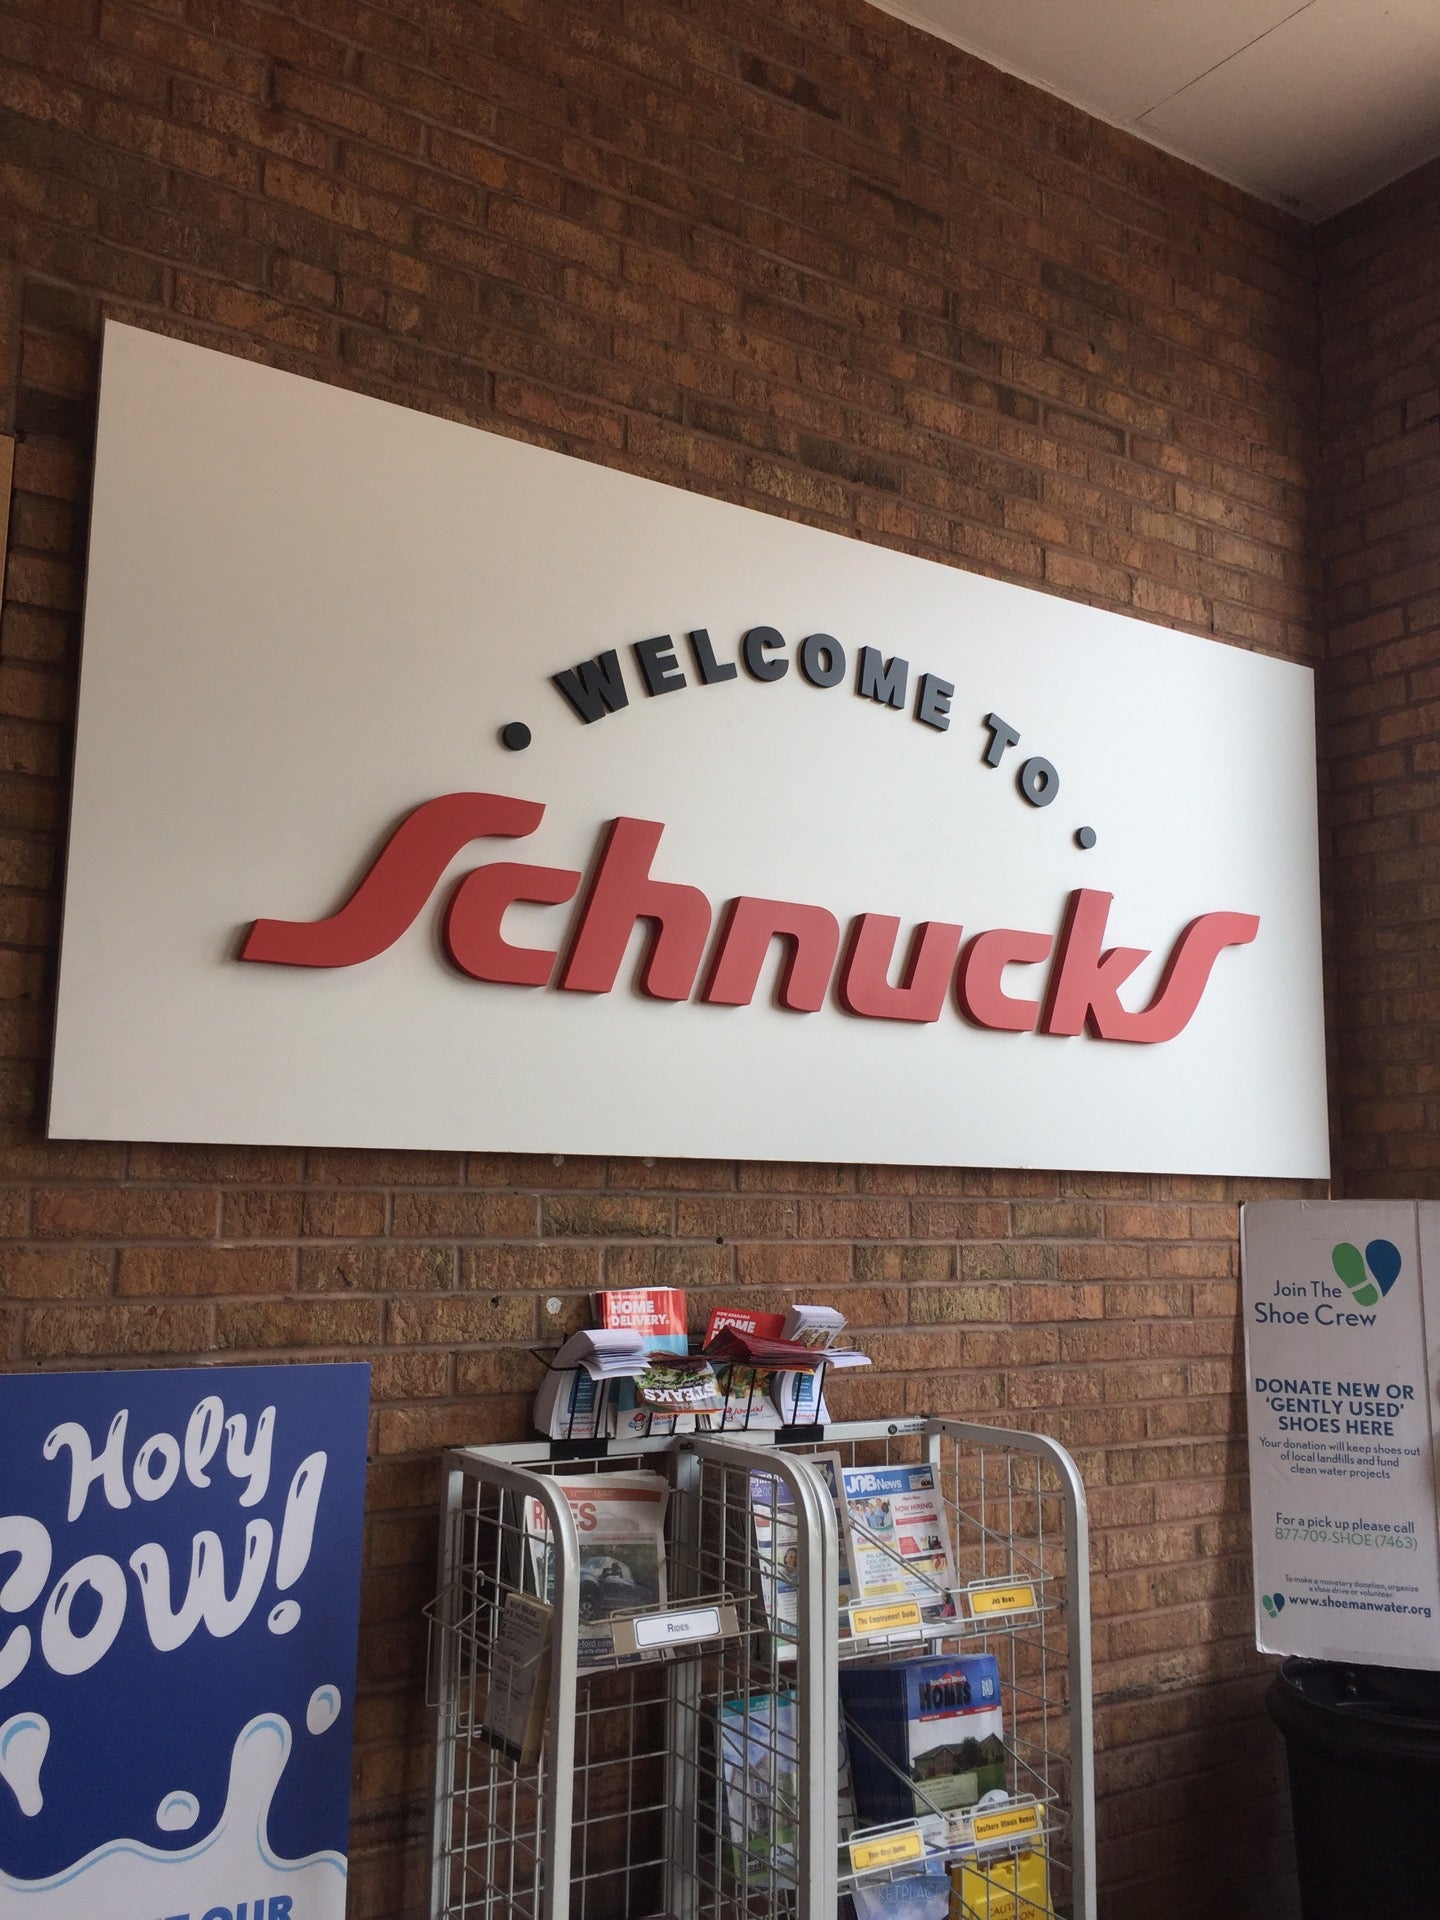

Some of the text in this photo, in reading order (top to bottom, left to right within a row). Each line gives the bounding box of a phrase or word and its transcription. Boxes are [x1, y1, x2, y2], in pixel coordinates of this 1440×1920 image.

[550, 625, 1060, 808] WELCOME TO
[237, 790, 1261, 1044] Schnucks
[1273, 1280, 1342, 1298] Join The
[610, 1300, 655, 1314] HOME
[1254, 1302, 1377, 1326] Shoe Crew
[713, 1317, 756, 1333] HOME
[1255, 1378, 1414, 1400] DONATE NEW OR
[1266, 1397, 1404, 1418] 'GENTLY USED'
[1278, 1416, 1394, 1436] SHOES HERE
[1259, 1437, 1420, 1456] Your donation will keep shoes out
[43, 1395, 276, 1522] Holy
[1280, 1451, 1399, 1467] of local landfills and fund
[1290, 1464, 1390, 1479] clean water projects
[533, 1500, 598, 1531] RES
[895, 1502, 934, 1513] NOW HIRING
[1276, 1512, 1415, 1533] For a pick up please call
[1275, 1527, 1418, 1551] 877-709-SHOE (7463)
[1285, 1574, 1293, 1582] To
[1319, 1579, 1352, 1588] monetary
[991, 1596, 1015, 1605] Job News
[1289, 1595, 1432, 1618] www.shoemanwater.org
[858, 1610, 916, 1626] The Employment Guide
[976, 1815, 1035, 1834] Southern Illinois Homes
